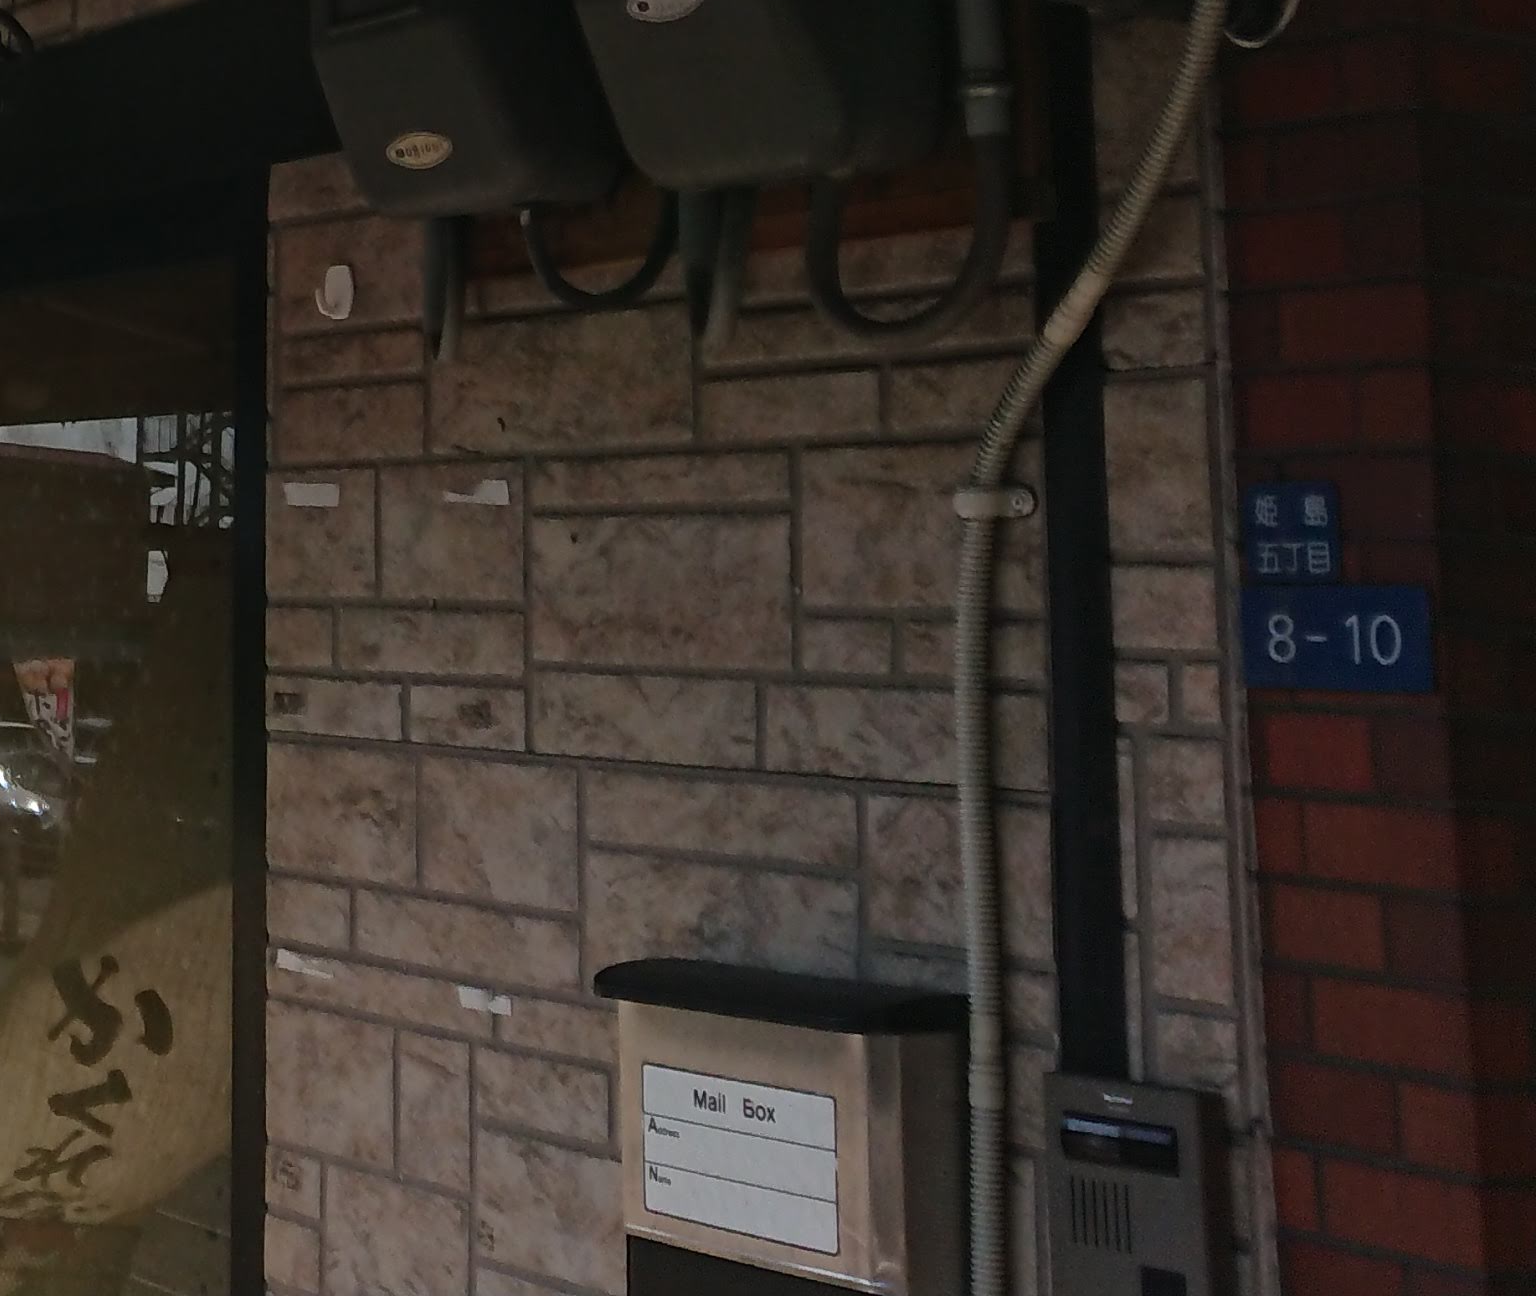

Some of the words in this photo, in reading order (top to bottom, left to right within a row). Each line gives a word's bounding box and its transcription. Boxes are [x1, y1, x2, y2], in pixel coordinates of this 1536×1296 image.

[1257, 542, 1331, 574] 五丁目
[1268, 613, 1402, 665] 8-10
[693, 1088, 726, 1115] Mail
